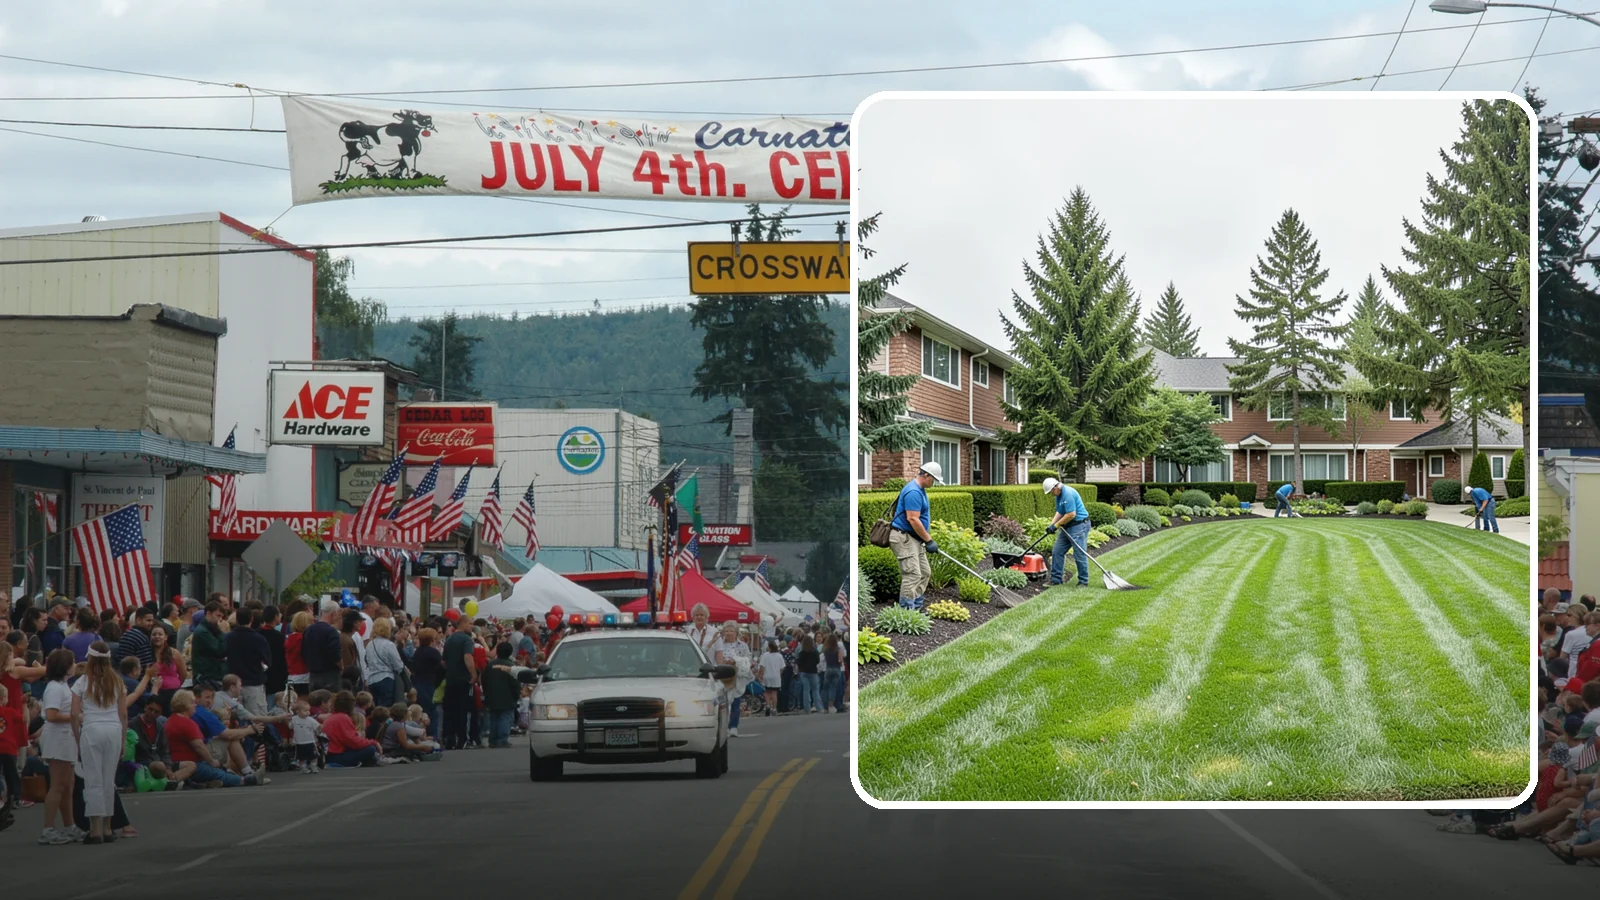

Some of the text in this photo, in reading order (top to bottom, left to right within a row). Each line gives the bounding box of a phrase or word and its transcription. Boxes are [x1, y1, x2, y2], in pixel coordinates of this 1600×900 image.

[695, 121, 850, 149] Carnat
[481, 141, 604, 192] JULY
[633, 150, 746, 197] 4th.
[697, 254, 850, 280] CROSSWA
[283, 380, 373, 420] ACE
[406, 409, 452, 422] CEDAR
[284, 421, 371, 436] Hardware
[95, 485, 124, 494] Vincent
[126, 486, 136, 494] de
[138, 486, 155, 495] Paul
[212, 515, 331, 535] HARDARE
[688, 526, 741, 535] CRNATION
[699, 535, 730, 543] GLASS
